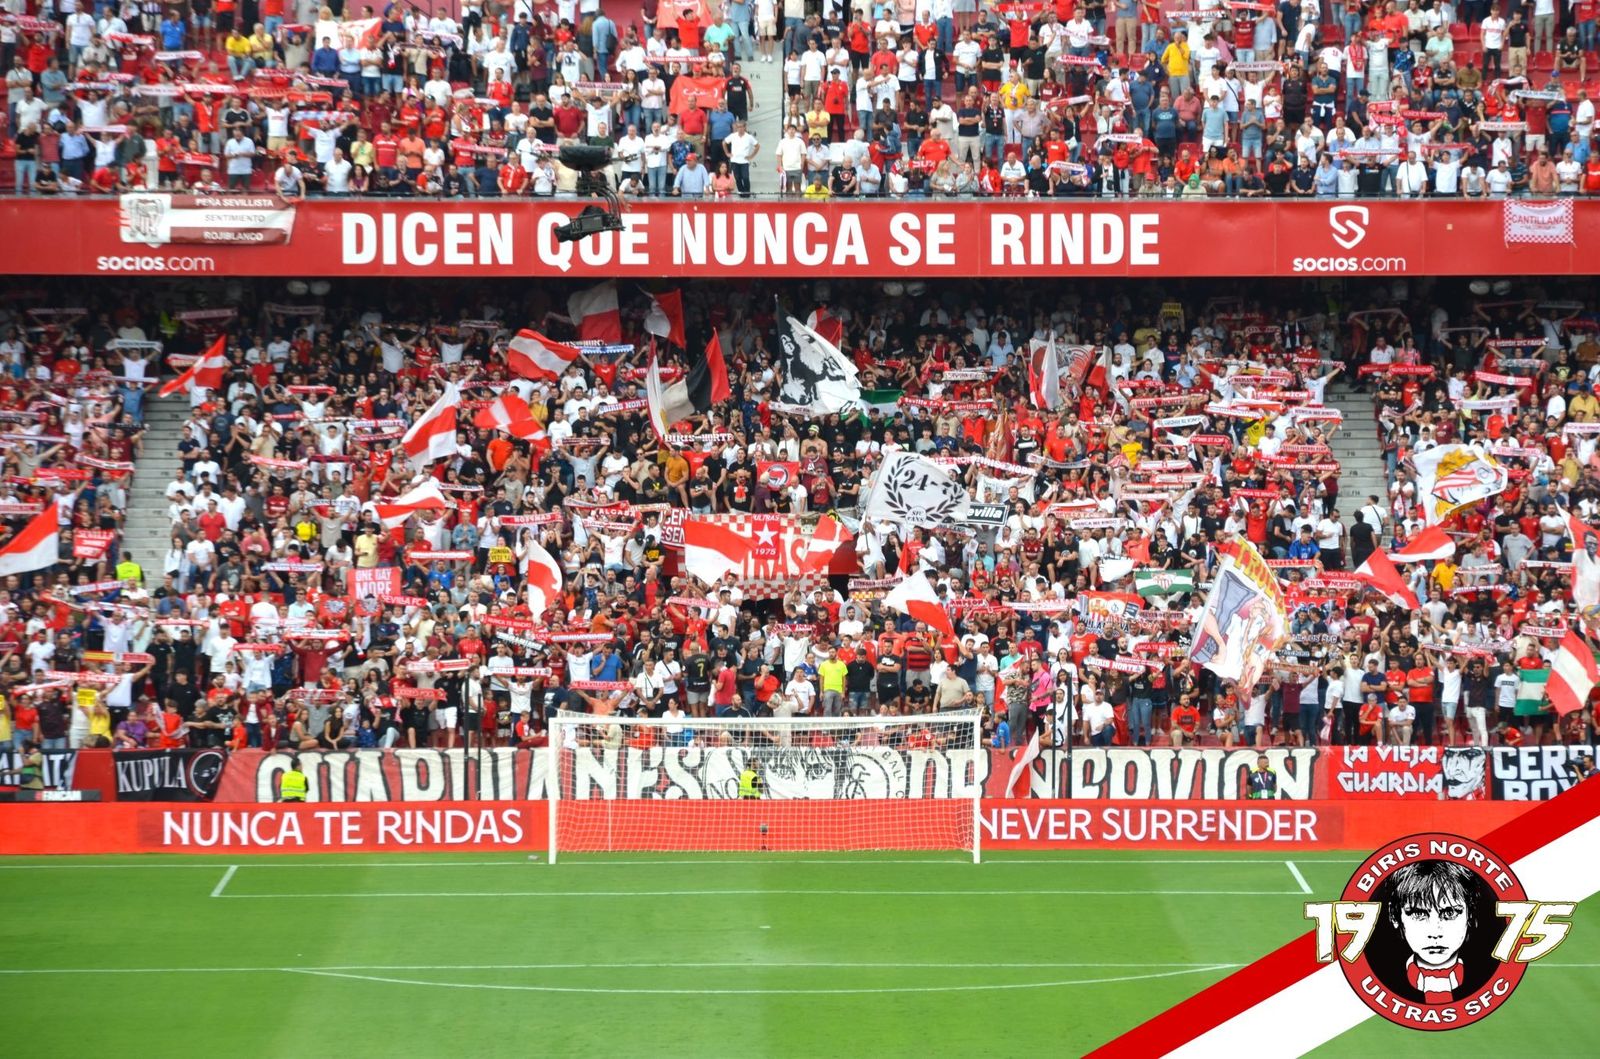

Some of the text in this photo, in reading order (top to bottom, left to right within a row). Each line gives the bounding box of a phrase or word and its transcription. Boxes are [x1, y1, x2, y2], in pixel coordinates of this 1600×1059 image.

[195, 196, 274, 208] PEÑA SEVILLISTA
[205, 214, 265, 223] SENTIMIENTO
[1512, 215, 1565, 225] CANTILLANA
[203, 231, 264, 241] ROJIBLANCO
[342, 212, 1160, 272] DICEN QUE NUNCA SE RINDE
[603, 400, 648, 413] BIRIS NORT
[967, 506, 1003, 519] evilla
[355, 568, 392, 581] ONE DAY
[355, 581, 392, 600] MORE
[382, 594, 422, 606] SEVILLA FC
[950, 599, 985, 607] AMPEON
[697, 663, 704, 677] 7
[1343, 745, 1438, 769] LA VIEJA
[117, 757, 187, 793] KUPULA
[1336, 772, 1443, 796] GUARDIA
[163, 809, 525, 846] NUNCA TE RINDAS
[979, 807, 1319, 842] NEVER SURRENDER
